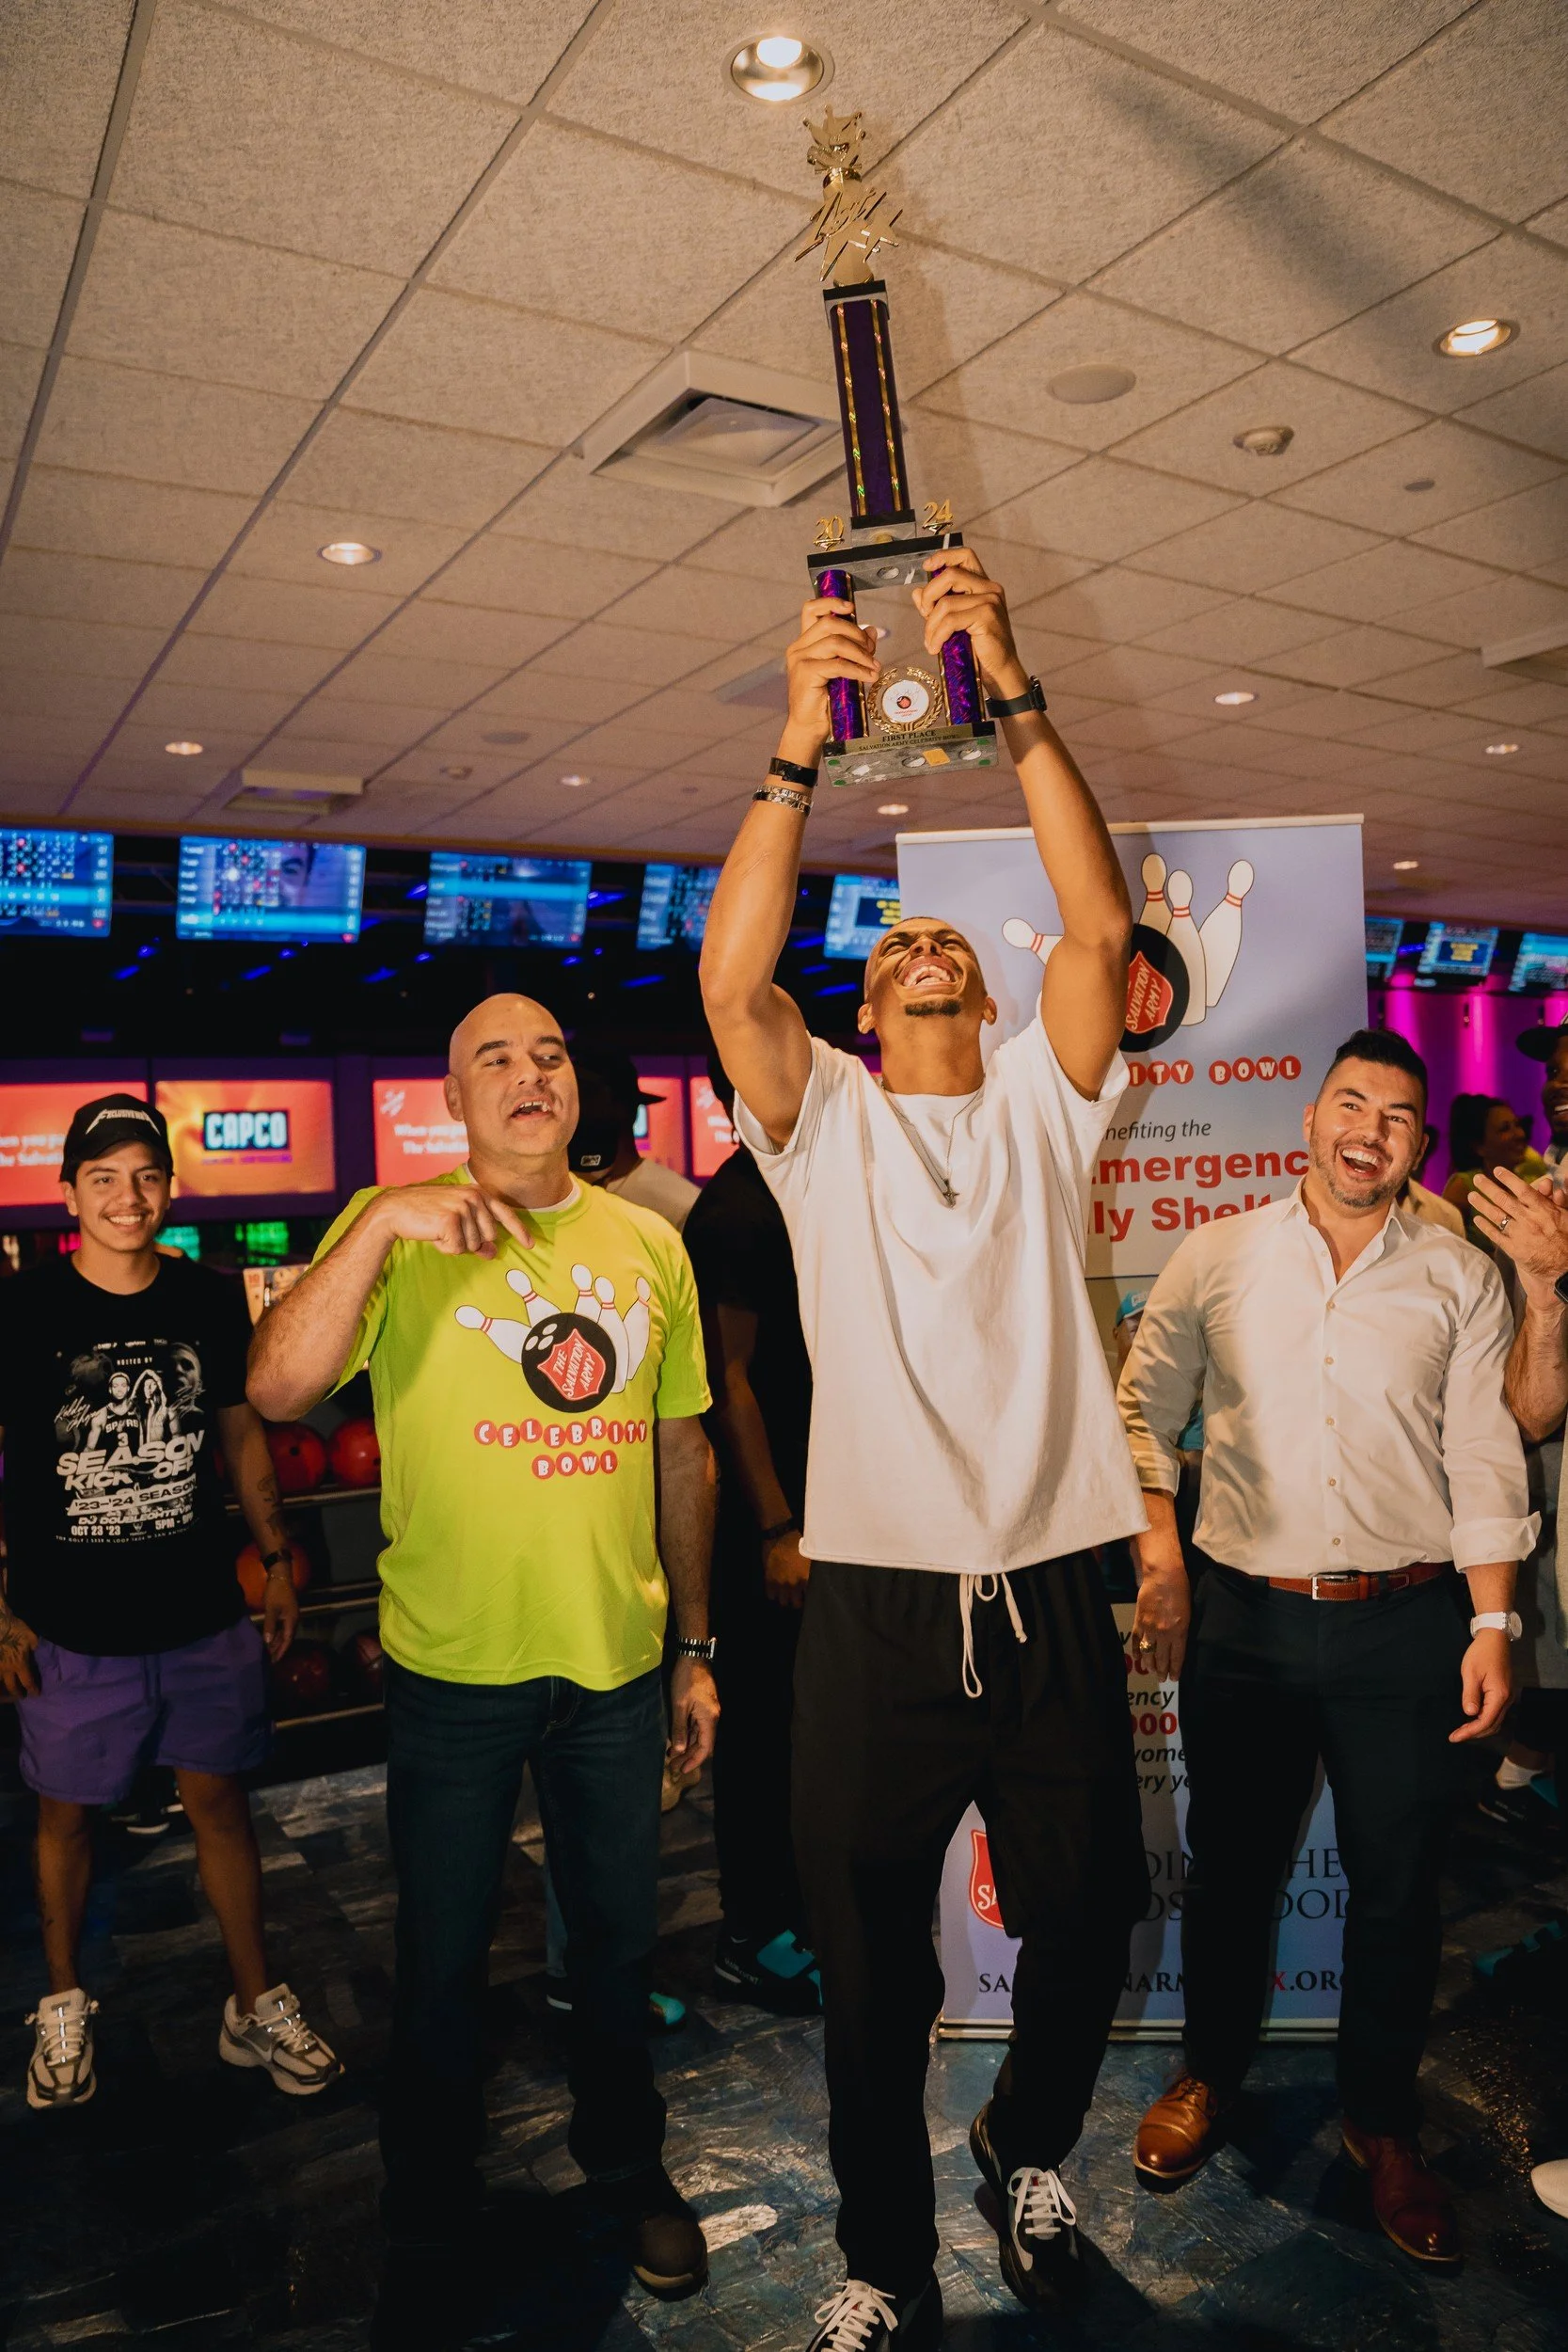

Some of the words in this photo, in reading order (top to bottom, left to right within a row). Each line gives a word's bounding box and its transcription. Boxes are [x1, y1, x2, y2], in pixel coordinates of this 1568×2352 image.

[815, 516, 844, 542] 20
[923, 499, 953, 527] 24
[859, 742, 892, 751] SALVATION
[882, 733, 907, 742] FIRST
[909, 729, 937, 740] PLACE
[1125, 961, 1151, 1030] SALVATION
[1145, 977, 1163, 1024] ARMY
[1212, 1058, 1298, 1084] BOWL
[204, 1111, 288, 1150] CAPCO
[1101, 1121, 1176, 1142] nefiting
[1181, 1119, 1212, 1137] the
[1092, 1150, 1309, 1188] mergenc
[552, 1351, 568, 1375] THE
[562, 1337, 586, 1399] SALVATION
[578, 1352, 596, 1391] ARMY
[118, 1433, 129, 1447] 3
[478, 1417, 645, 1447] CELEBRITY
[56, 1430, 205, 1476] SEASON
[535, 1453, 615, 1478] BOWL
[64, 1470, 133, 1491] KICK
[153, 1454, 194, 1479] OFF
[139, 1477, 198, 1502] SEASON
[71, 1525, 89, 1536] OCT
[91, 1525, 103, 1535] 23
[105, 1525, 121, 1535] '23
[155, 1517, 175, 1531] 5PM
[78, 1515, 98, 1526] DJ
[978, 1973, 1011, 1993] SA
[1270, 1970, 1343, 1992] X.OR
